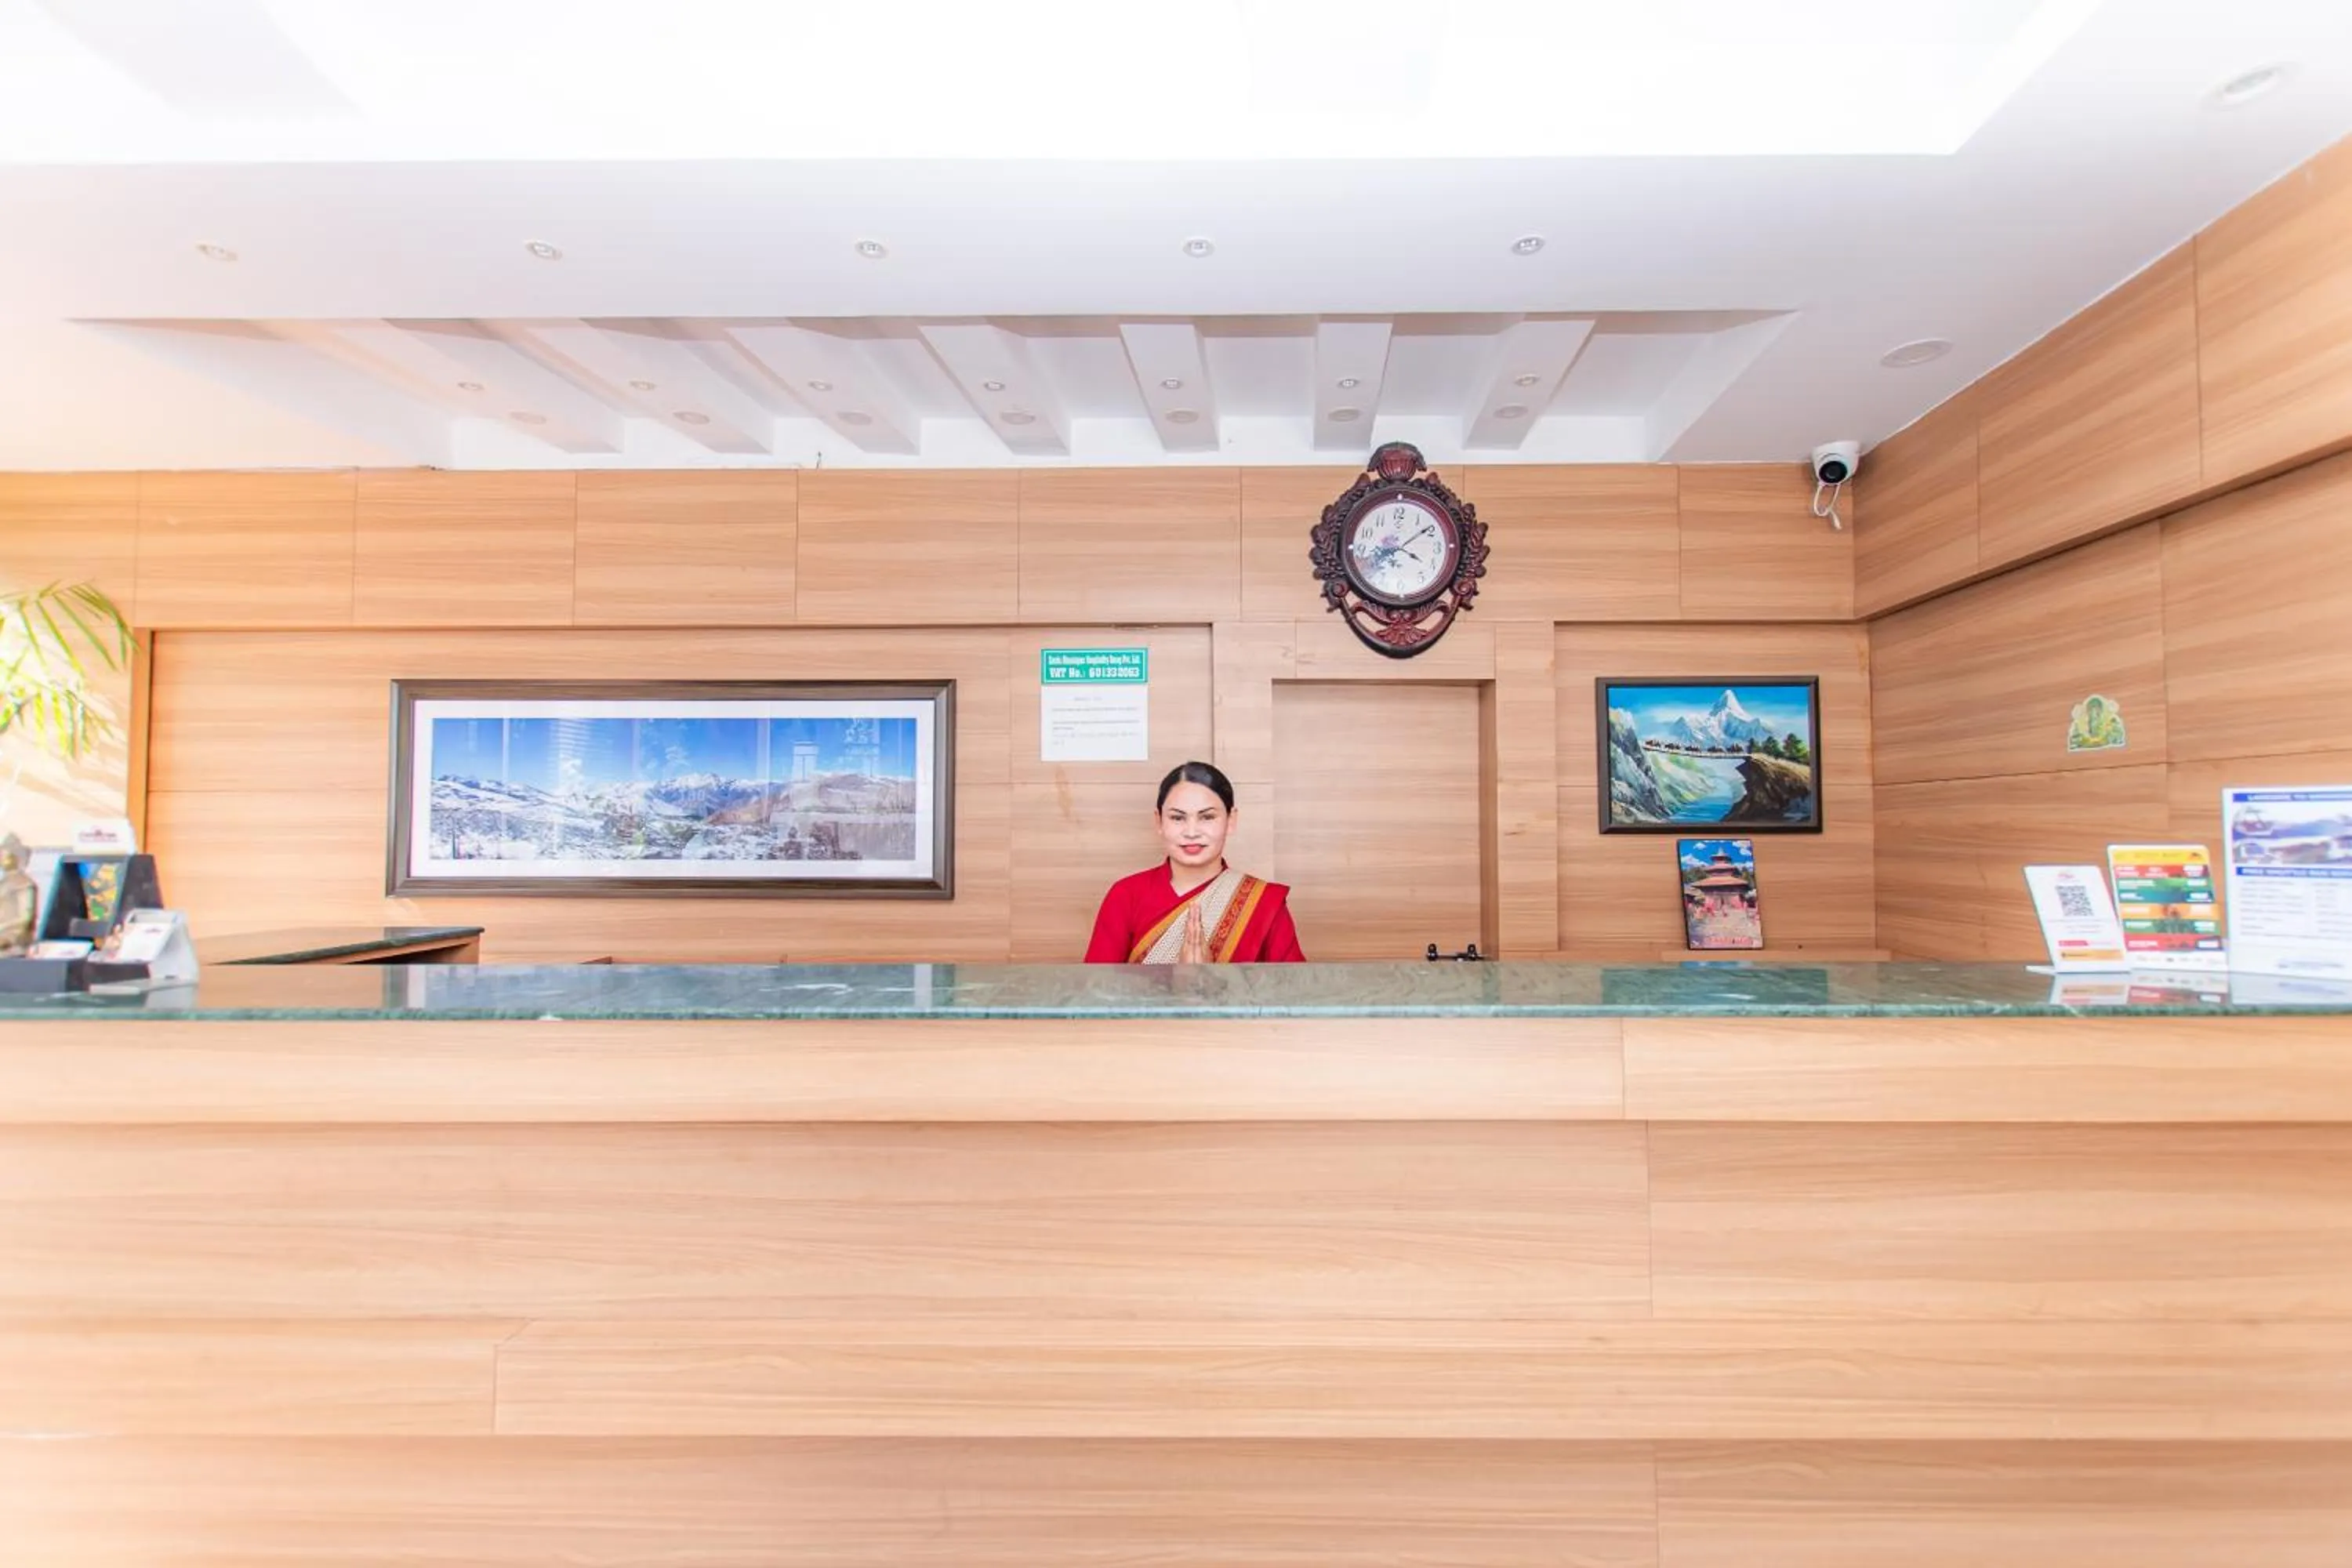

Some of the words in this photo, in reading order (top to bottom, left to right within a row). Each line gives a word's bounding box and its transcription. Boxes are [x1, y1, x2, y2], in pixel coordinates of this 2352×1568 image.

[1393, 506, 1405, 520] 12
[1375, 513, 1385, 528] 11
[1415, 514, 1421, 526] 1
[1361, 527, 1374, 539] 10
[1426, 524, 1436, 538] 2
[1050, 667, 1067, 678] VAT
